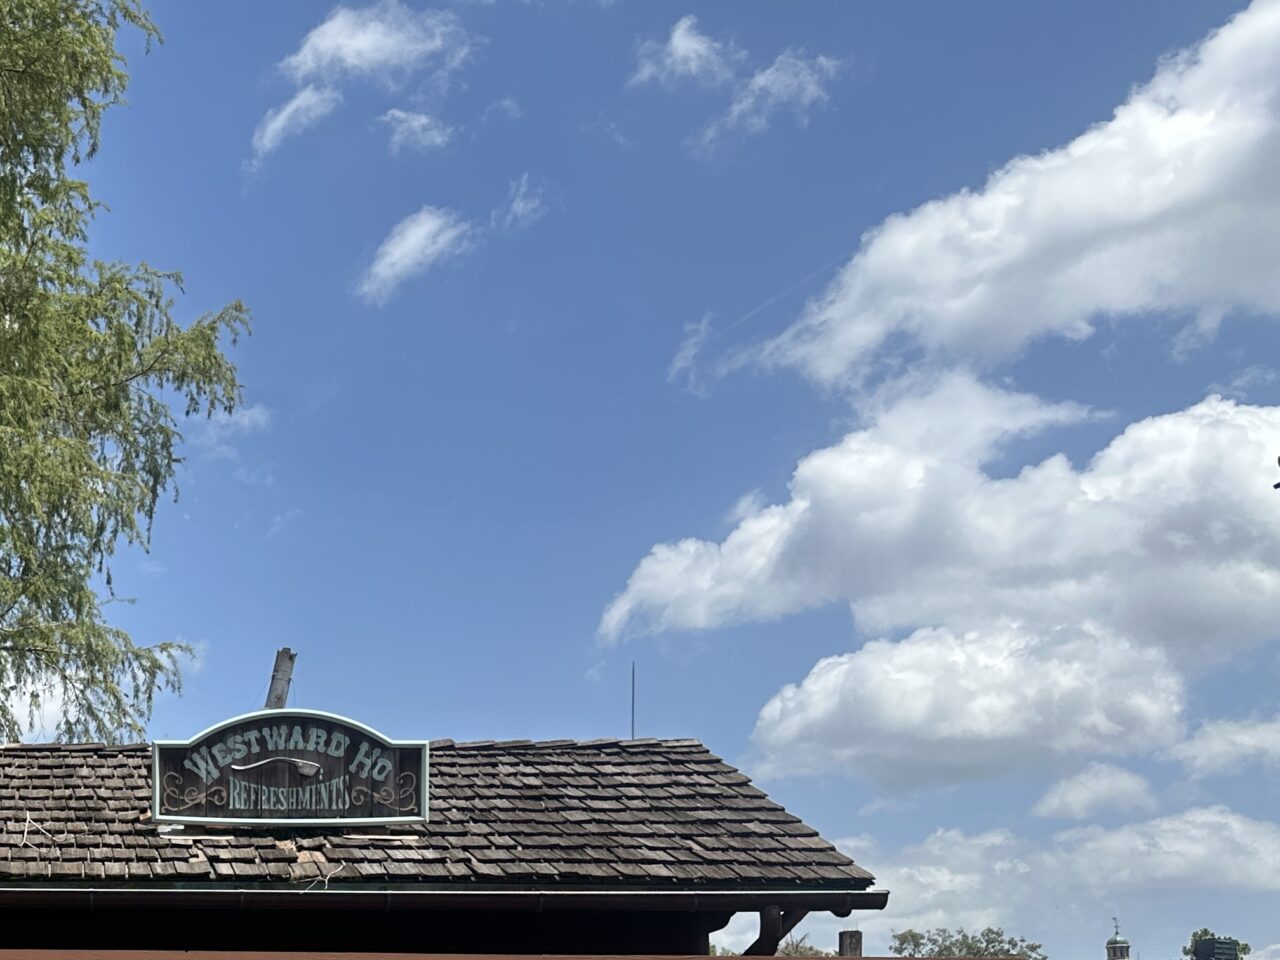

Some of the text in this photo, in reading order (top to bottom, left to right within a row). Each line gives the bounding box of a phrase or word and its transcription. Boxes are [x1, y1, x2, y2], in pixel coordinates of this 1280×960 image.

[183, 725, 393, 786] WESTWARD HO
[228, 775, 350, 811] REFRESHMENTS
